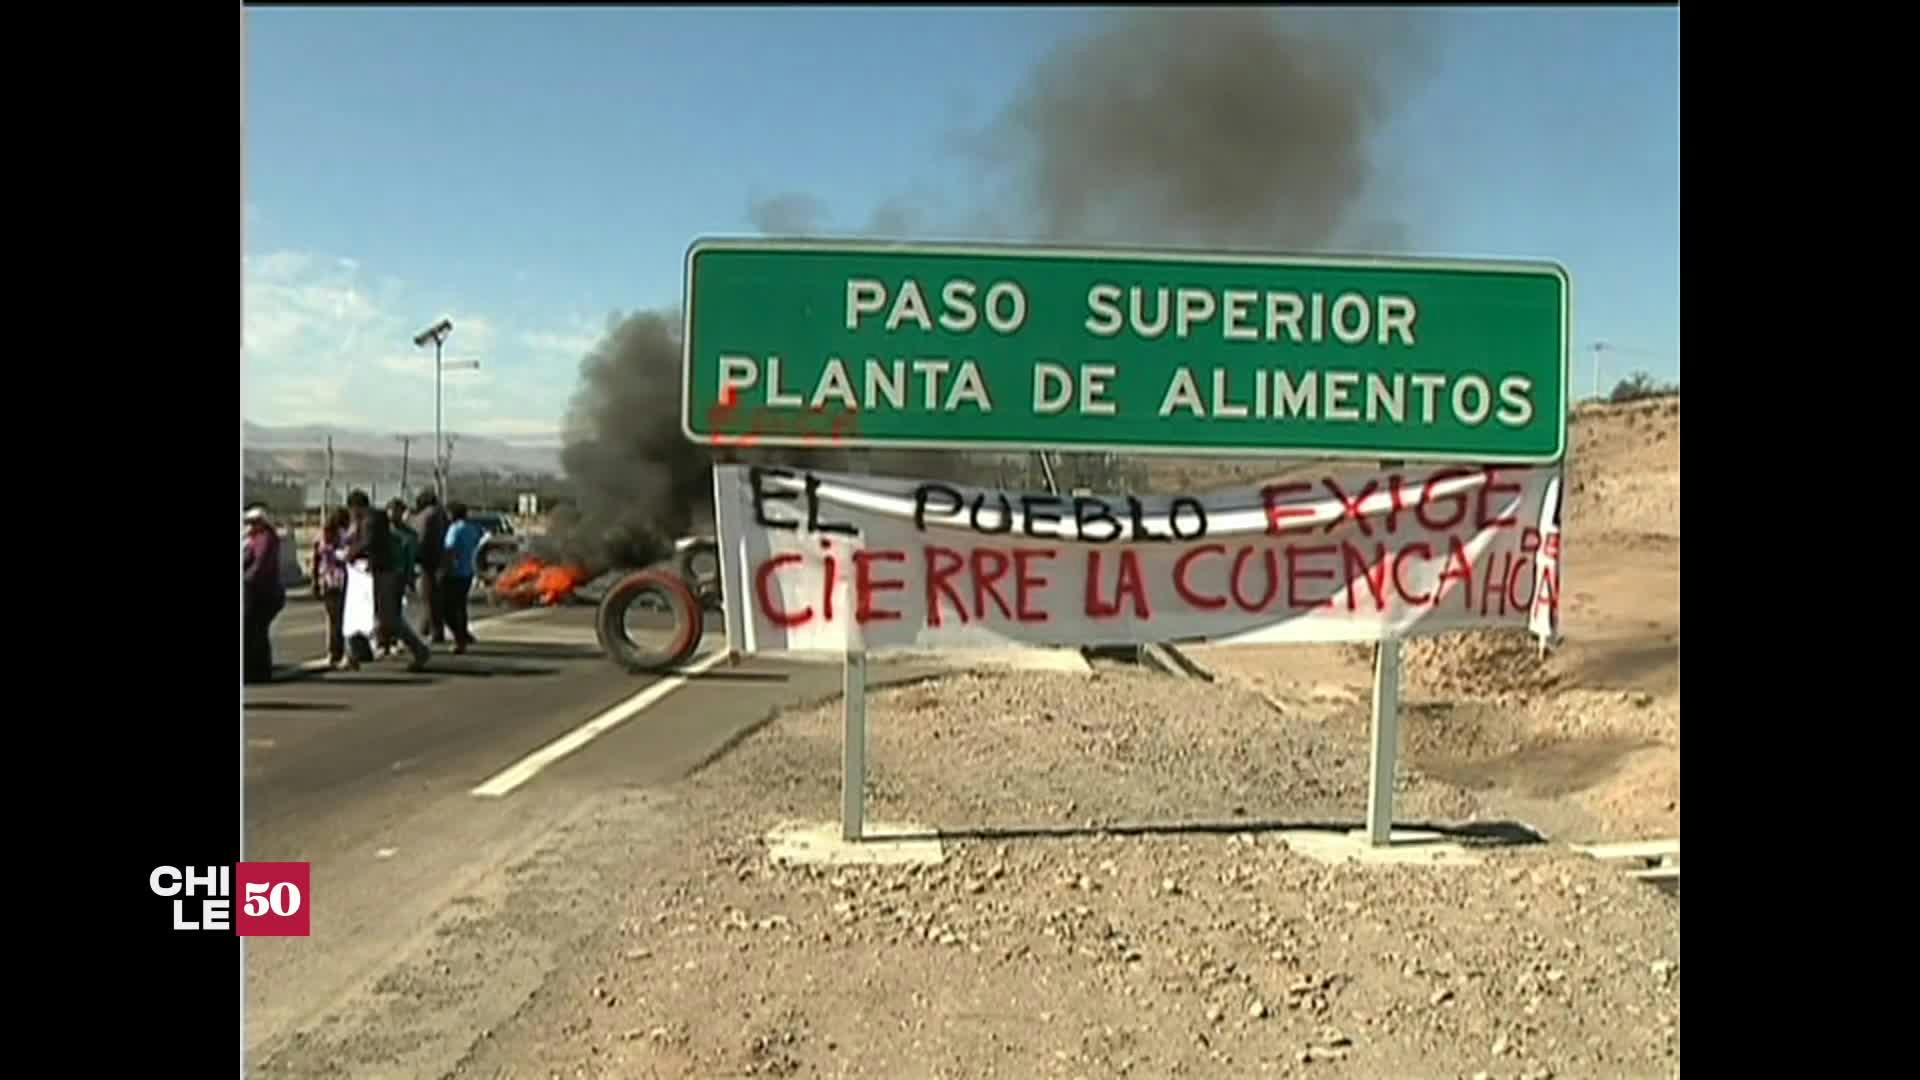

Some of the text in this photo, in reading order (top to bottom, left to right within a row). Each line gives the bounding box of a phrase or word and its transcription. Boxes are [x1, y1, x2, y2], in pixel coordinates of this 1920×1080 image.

[845, 278, 1418, 346] PASO SUPERIOR
[717, 355, 1534, 426] PLANTA DE ALIMENTOS
[750, 464, 1532, 543] EL PUEBLO EXIGE
[1083, 548, 1150, 620] LA
[1173, 536, 1473, 614] CUENCA
